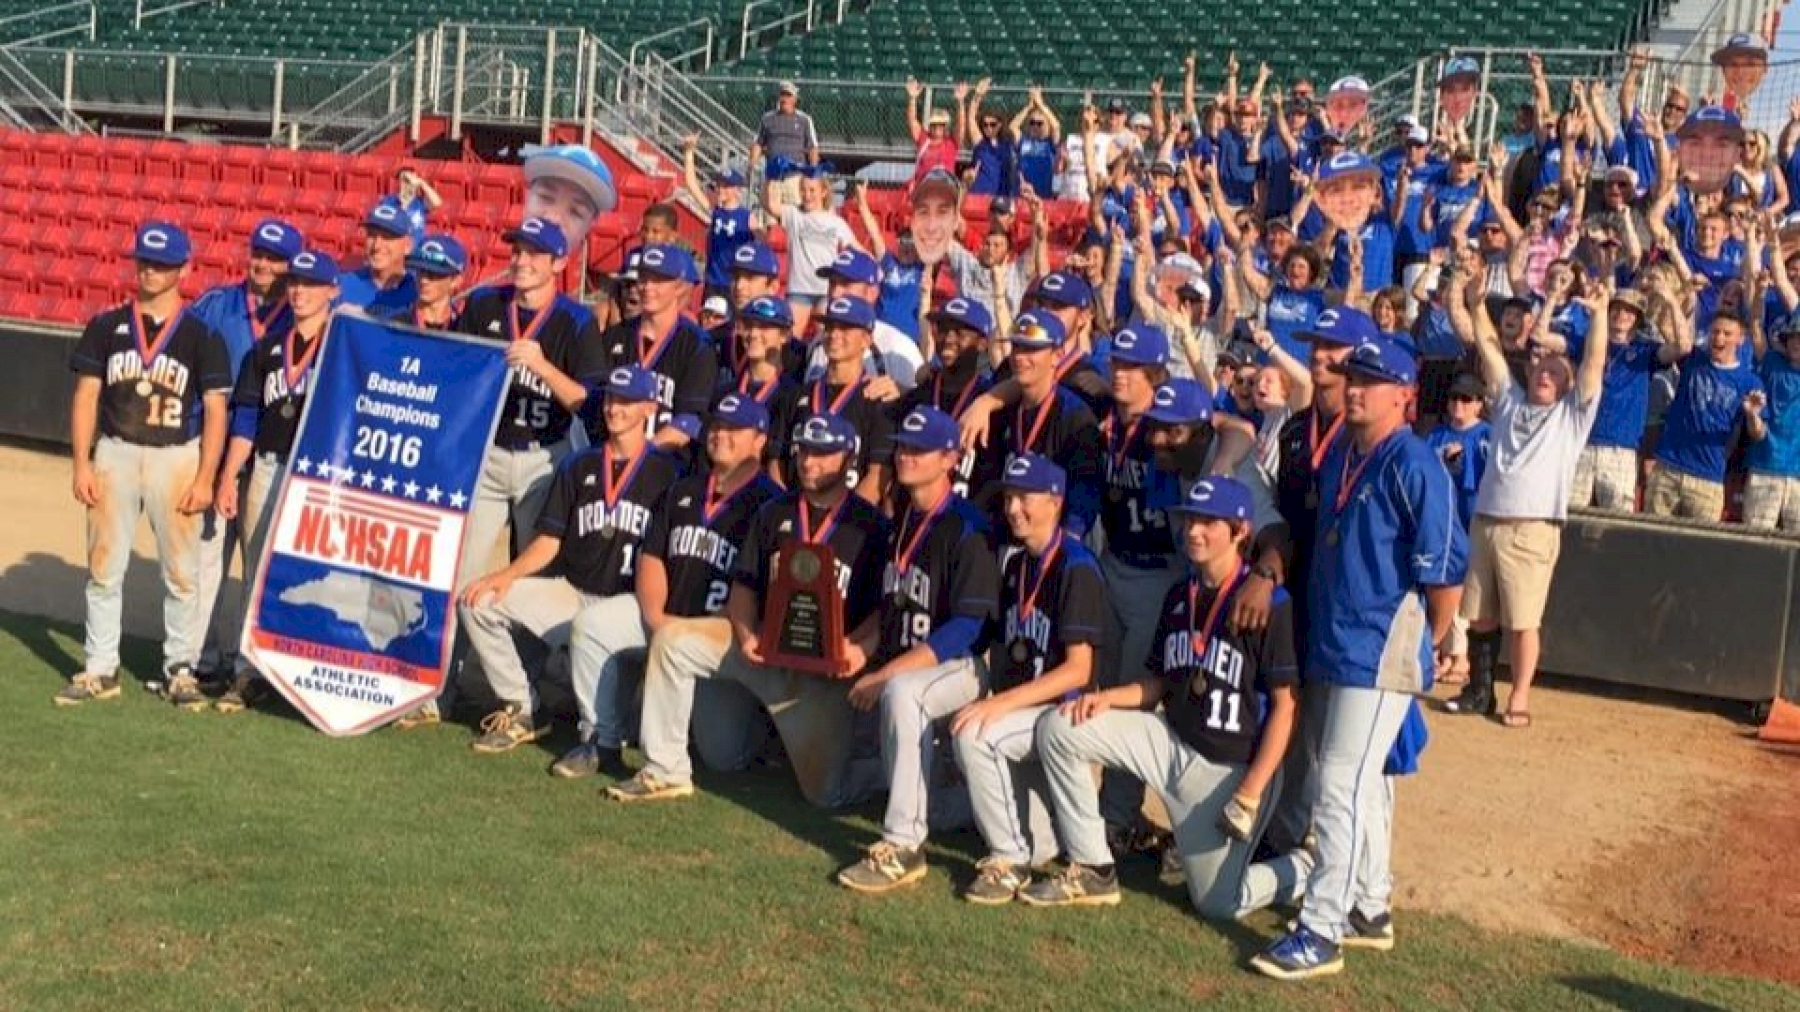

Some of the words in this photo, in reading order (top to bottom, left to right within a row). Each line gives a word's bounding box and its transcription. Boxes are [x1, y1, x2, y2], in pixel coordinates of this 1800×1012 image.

[143, 229, 169, 249] C
[260, 224, 284, 243] C
[293, 252, 317, 269] C
[1043, 273, 1065, 291] C
[1316, 309, 1340, 327] C
[1114, 330, 1138, 349] C
[108, 350, 189, 397] IROMEN
[400, 356, 421, 376] 1A
[610, 367, 632, 386] C
[367, 371, 438, 403] Baseball
[1154, 386, 1176, 406] C
[146, 394, 182, 429] 12
[356, 395, 441, 429] Champions
[514, 399, 550, 429] 15
[902, 411, 927, 431] C
[353, 426, 423, 468] 2016
[1007, 458, 1032, 476] C
[1189, 481, 1215, 501] C
[293, 504, 434, 582] NCHSAA
[705, 580, 729, 612] 2
[900, 611, 931, 647] 19
[311, 665, 380, 688] ATHLETIC
[293, 675, 395, 706] ASSOCIATION
[1206, 689, 1242, 732] 11
